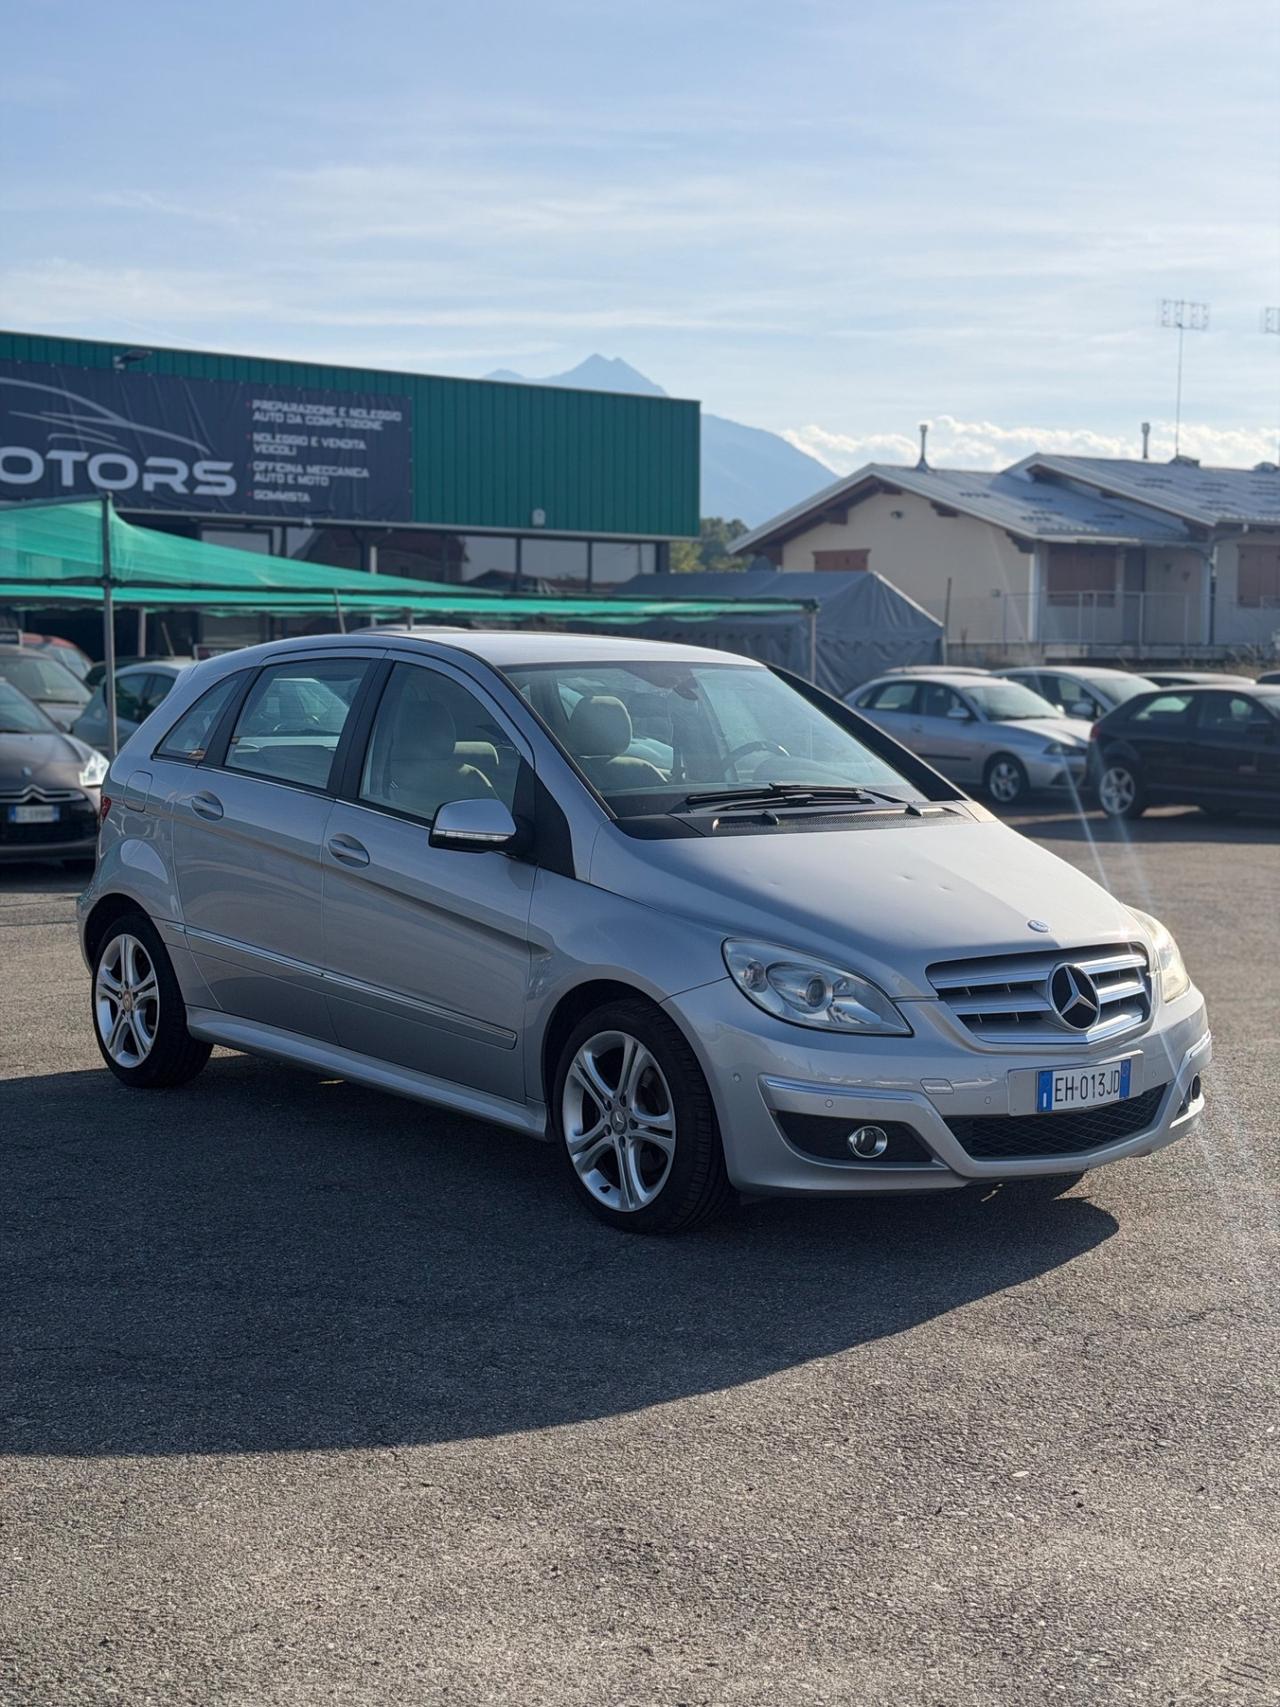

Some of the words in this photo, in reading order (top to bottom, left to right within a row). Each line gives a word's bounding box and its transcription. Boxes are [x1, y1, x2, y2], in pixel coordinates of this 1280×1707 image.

[253, 412, 284, 423] AUTO
[287, 414, 303, 424] DA
[306, 415, 383, 431] COMPETIZIONE
[339, 407, 346, 417] E
[350, 408, 402, 422] NOLEGGIO
[253, 433, 308, 446] NOLEGGIO
[311, 437, 318, 447] E
[321, 438, 366, 449] VENDITA
[254, 444, 297, 456] VEICOLI
[0, 446, 237, 496] OTORS
[253, 461, 303, 474] OFFICINA
[306, 465, 369, 478] MECCANICA
[254, 473, 285, 484] AUTO
[287, 475, 295, 484] E
[298, 476, 329, 486] MOTO
[254, 490, 310, 502] GOMMISTA
